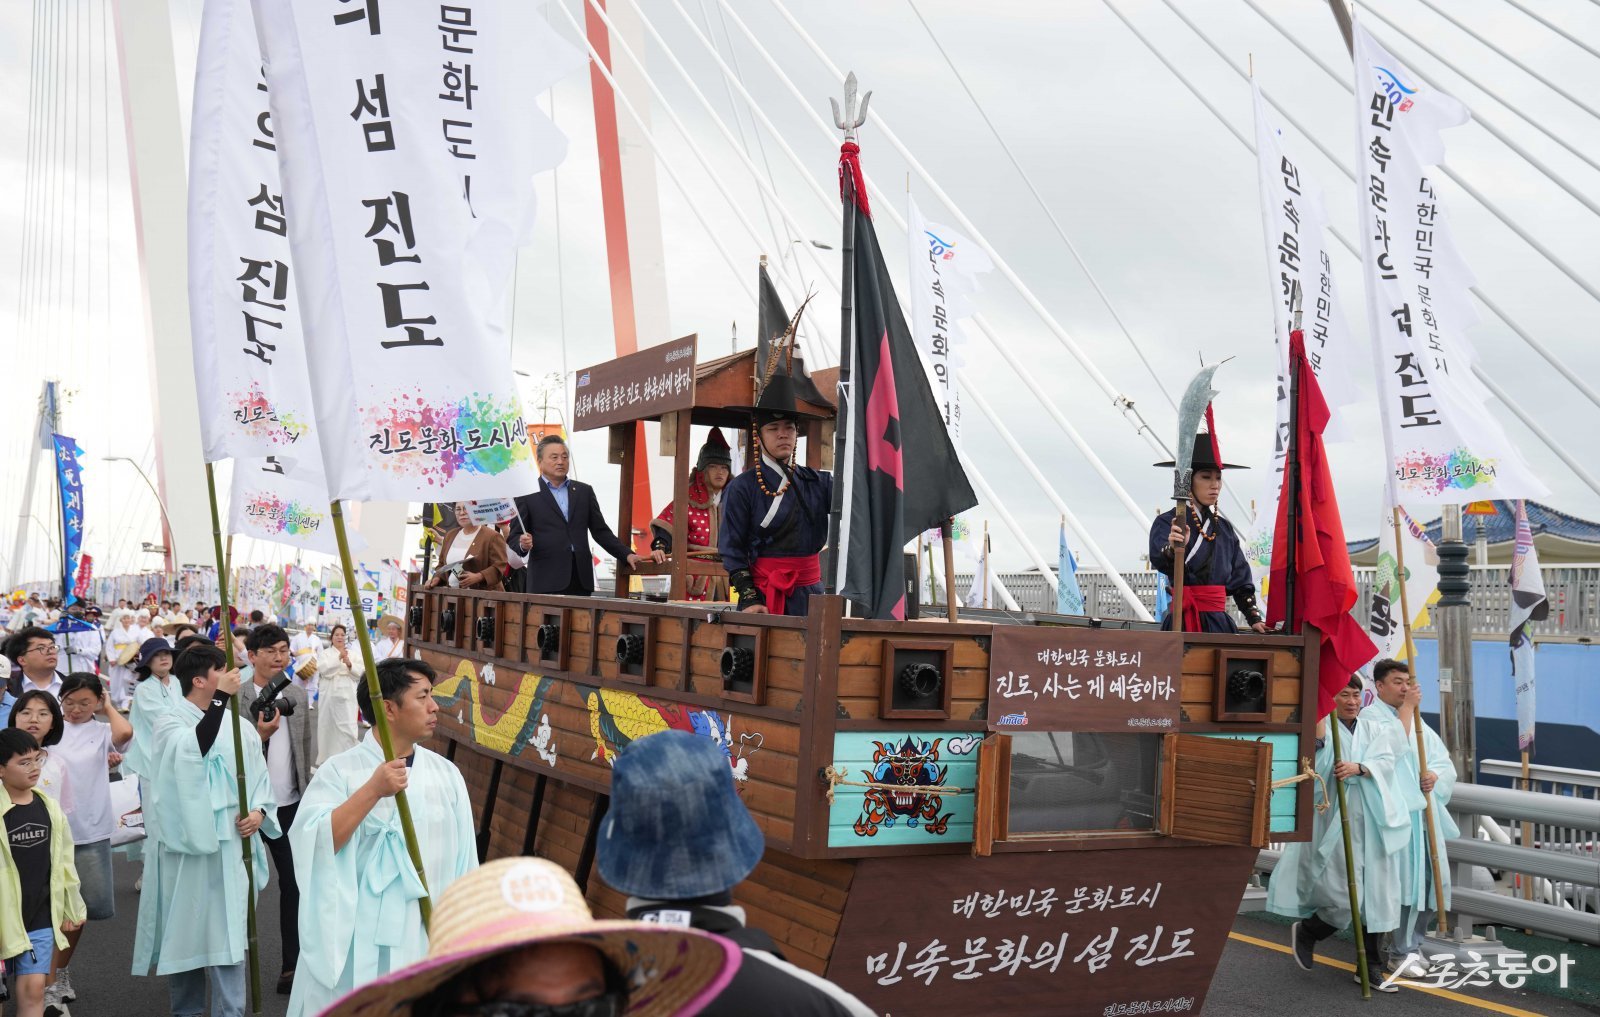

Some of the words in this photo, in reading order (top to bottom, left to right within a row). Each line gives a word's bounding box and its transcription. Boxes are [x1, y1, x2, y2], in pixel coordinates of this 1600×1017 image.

[350, 74, 395, 152] 섬
[362, 191, 445, 349] 진도
[236, 256, 290, 366] 진도
[1394, 352, 1442, 429] 진도
[369, 417, 528, 455] 진도문화도시센
[1037, 649, 1090, 667] 대한민국
[1094, 650, 1141, 667] 문화도시
[996, 671, 1038, 701] 진도,
[1043, 672, 1082, 700] 사는
[1087, 674, 1105, 700] 게
[1109, 673, 1176, 703] 예술이다
[12, 829, 46, 842] MILLET
[952, 888, 1059, 919] 대한민국
[1065, 882, 1162, 914] 문화도시
[866, 932, 1068, 986] 민속문화의
[1073, 927, 1120, 974] 섬
[1124, 925, 1196, 968] 진도
